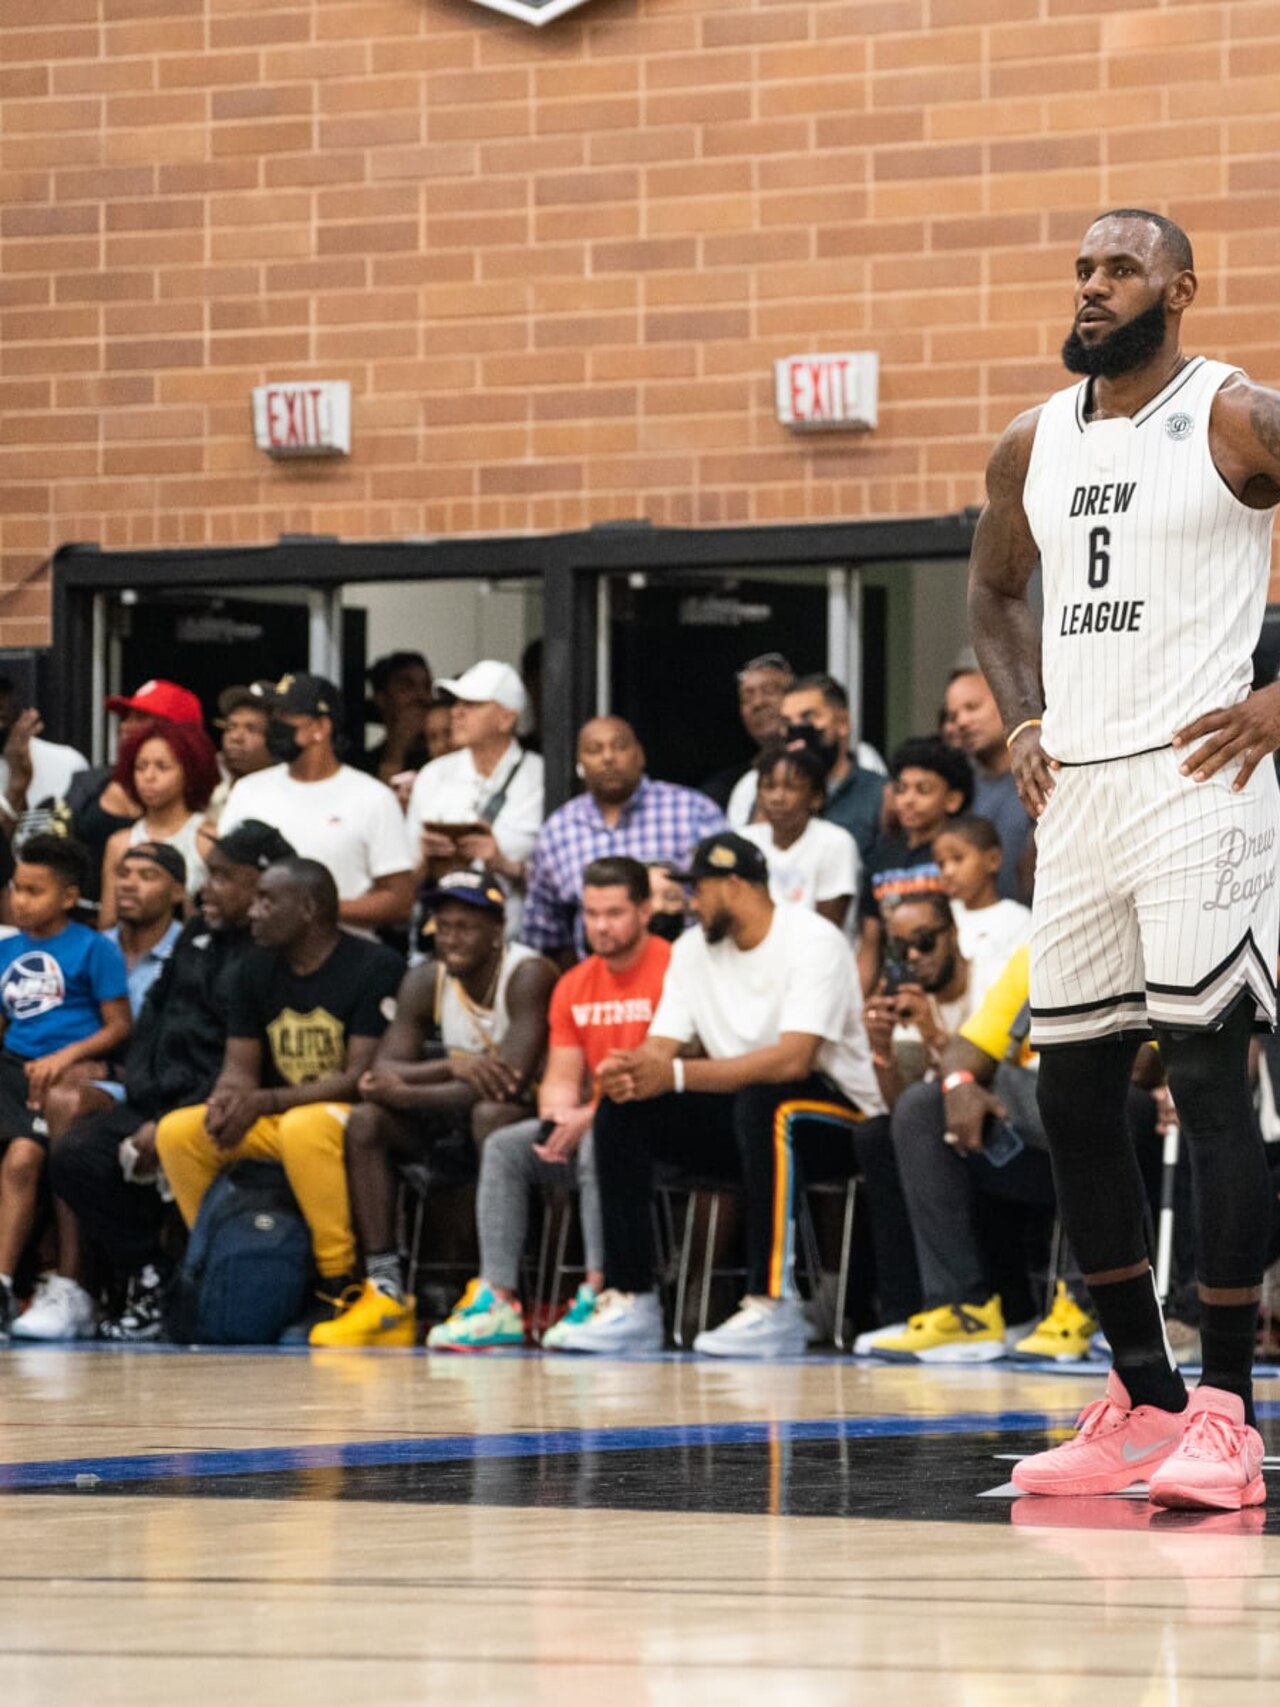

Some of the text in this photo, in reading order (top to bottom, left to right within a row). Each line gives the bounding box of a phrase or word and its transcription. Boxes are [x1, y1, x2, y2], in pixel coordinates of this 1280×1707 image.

[789, 359, 849, 420] EXIT
[267, 389, 322, 447] EXIT
[1069, 482, 1137, 518] DREW
[1088, 526, 1111, 589] 6
[1060, 601, 1145, 637] LEAGUE
[1215, 826, 1276, 869] Drew
